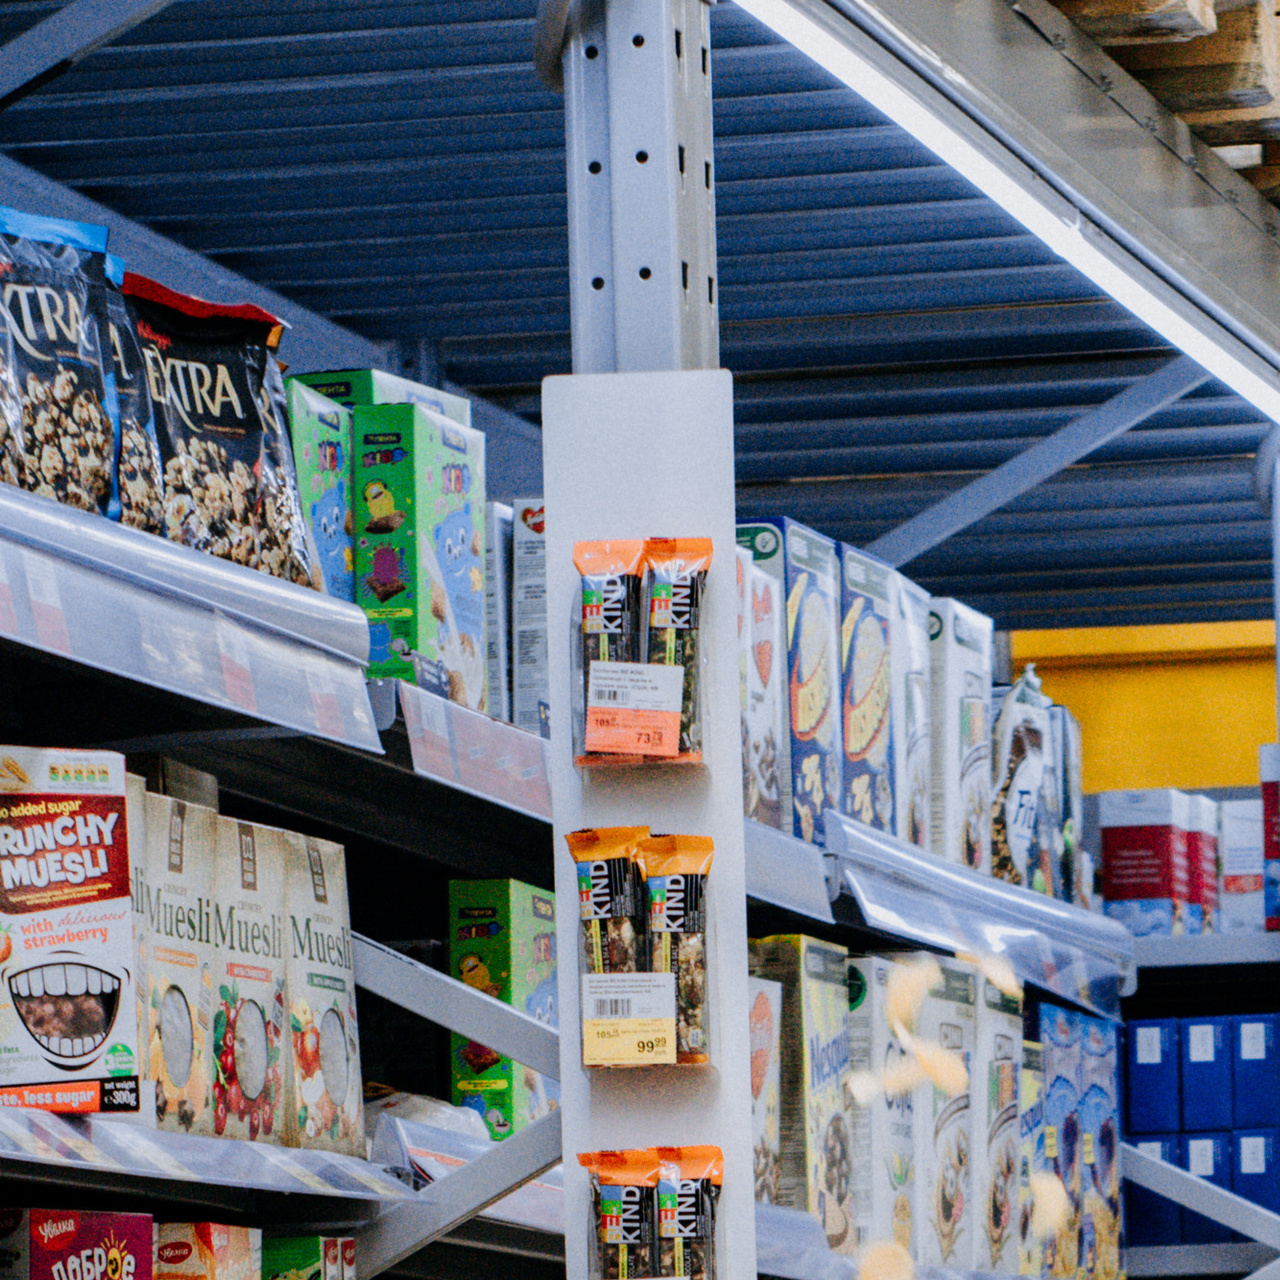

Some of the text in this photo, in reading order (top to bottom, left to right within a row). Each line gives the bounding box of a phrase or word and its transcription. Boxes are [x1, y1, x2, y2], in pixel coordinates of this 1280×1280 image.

[0, 284, 96, 361] XTRA
[142, 344, 246, 433] EXTRA
[362, 448, 408, 467] KIDS
[602, 574, 622, 633] KIND
[672, 571, 691, 629] KIND
[0, 812, 118, 856] RUNCHY
[10, 800, 82, 818] added sugar
[1, 849, 109, 890] MUESLI
[591, 860, 612, 918] KIND
[21, 918, 54, 936] with
[145, 884, 211, 944] Muesli
[666, 874, 686, 932] KIND
[23, 927, 108, 950] strawberry
[215, 903, 282, 959] Muesli
[290, 915, 352, 970] Muesli
[637, 1040, 654, 1053] 99
[24, 1090, 54, 1107] less
[55, 1090, 95, 1108] sugar
[39, 1218, 75, 1243] Увелка
[621, 1186, 641, 1244] KIND
[678, 1179, 698, 1237] KIND
